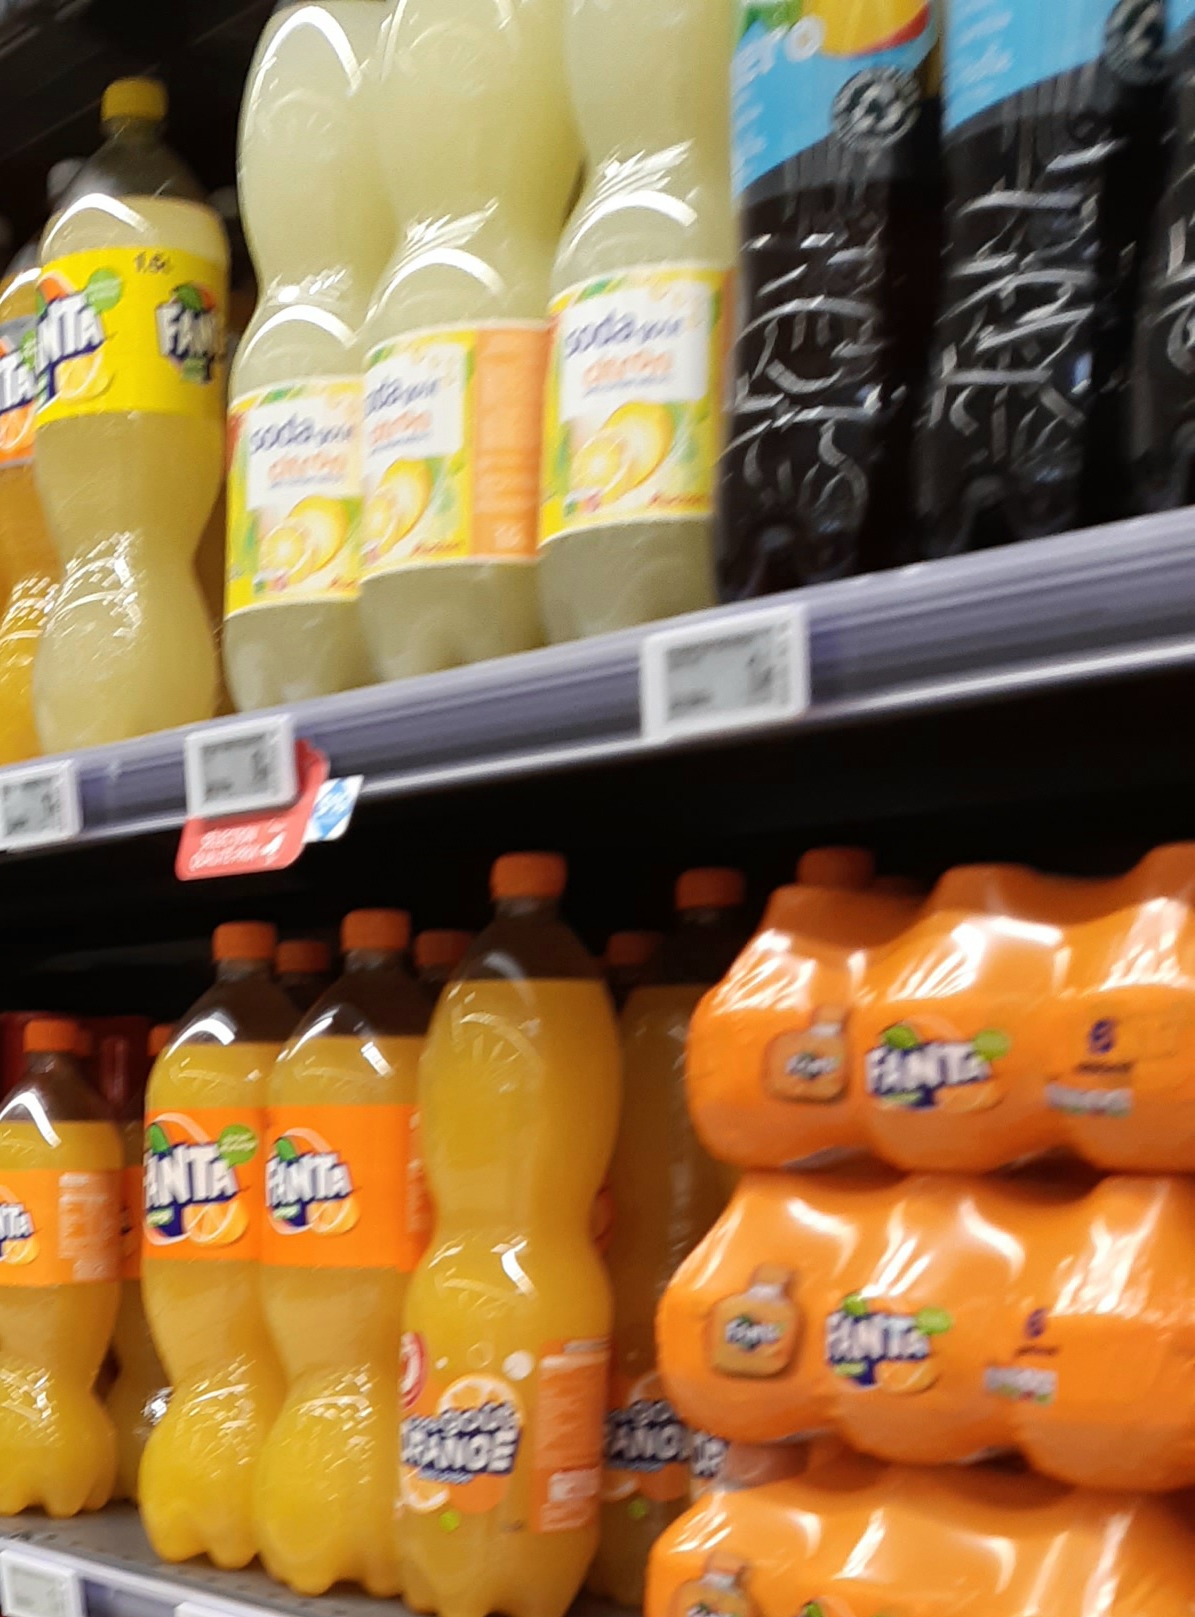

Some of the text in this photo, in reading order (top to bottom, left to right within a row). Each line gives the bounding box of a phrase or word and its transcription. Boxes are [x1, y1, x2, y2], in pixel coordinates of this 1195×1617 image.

[36, 292, 107, 380] NTA
[144, 1146, 239, 1208] ANTA
[402, 1420, 518, 1474] RANGE
